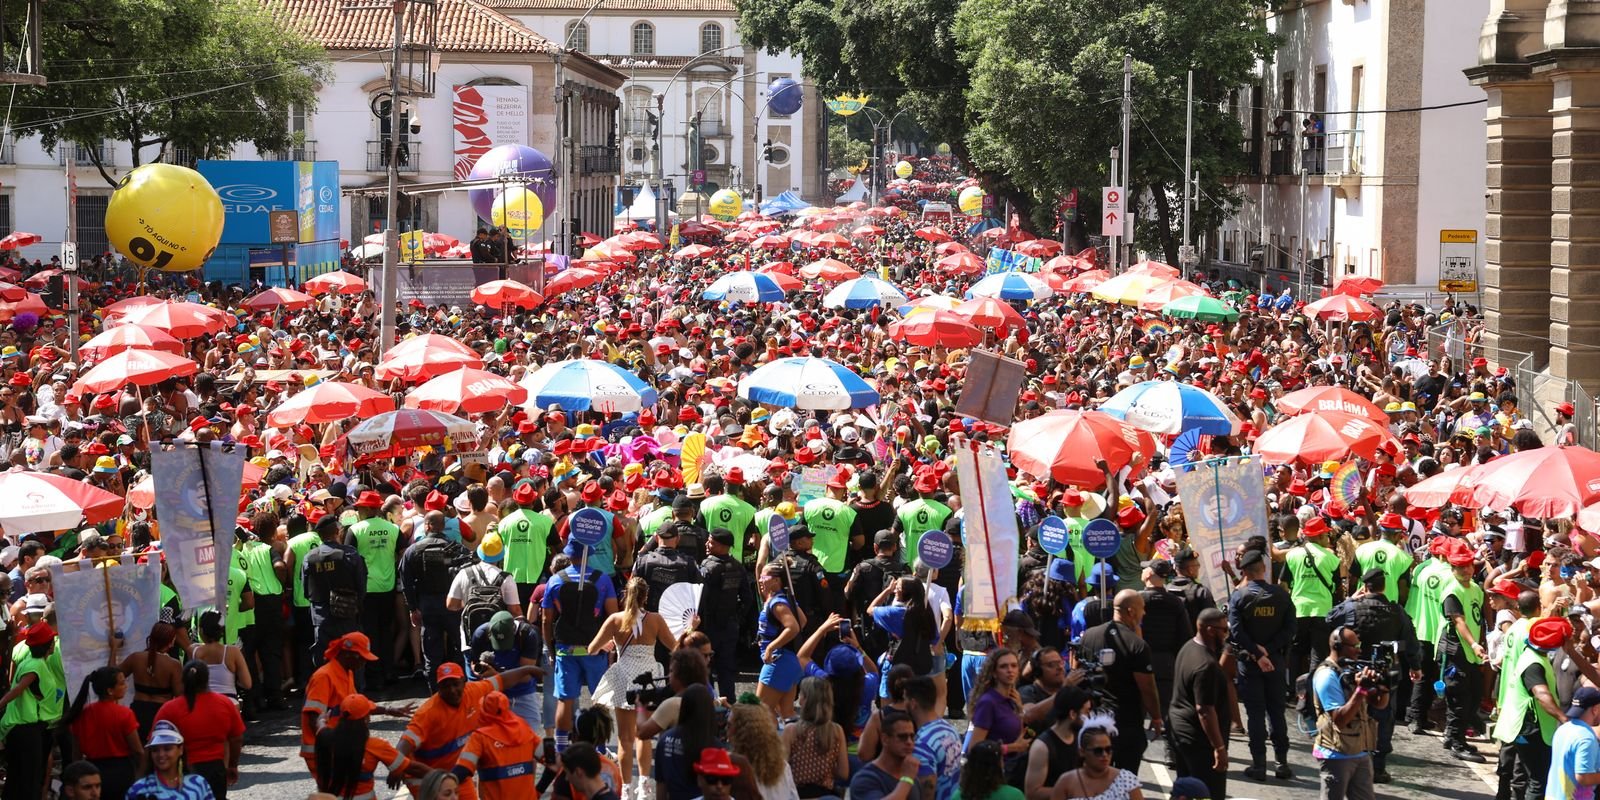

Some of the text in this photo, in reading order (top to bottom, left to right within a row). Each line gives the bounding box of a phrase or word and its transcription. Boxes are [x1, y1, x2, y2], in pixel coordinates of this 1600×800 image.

[223, 204, 284, 213] EDAE
[318, 204, 334, 213] CEDAE
[1318, 399, 1369, 417] BRAHMA
[368, 529, 389, 537] APOIO
